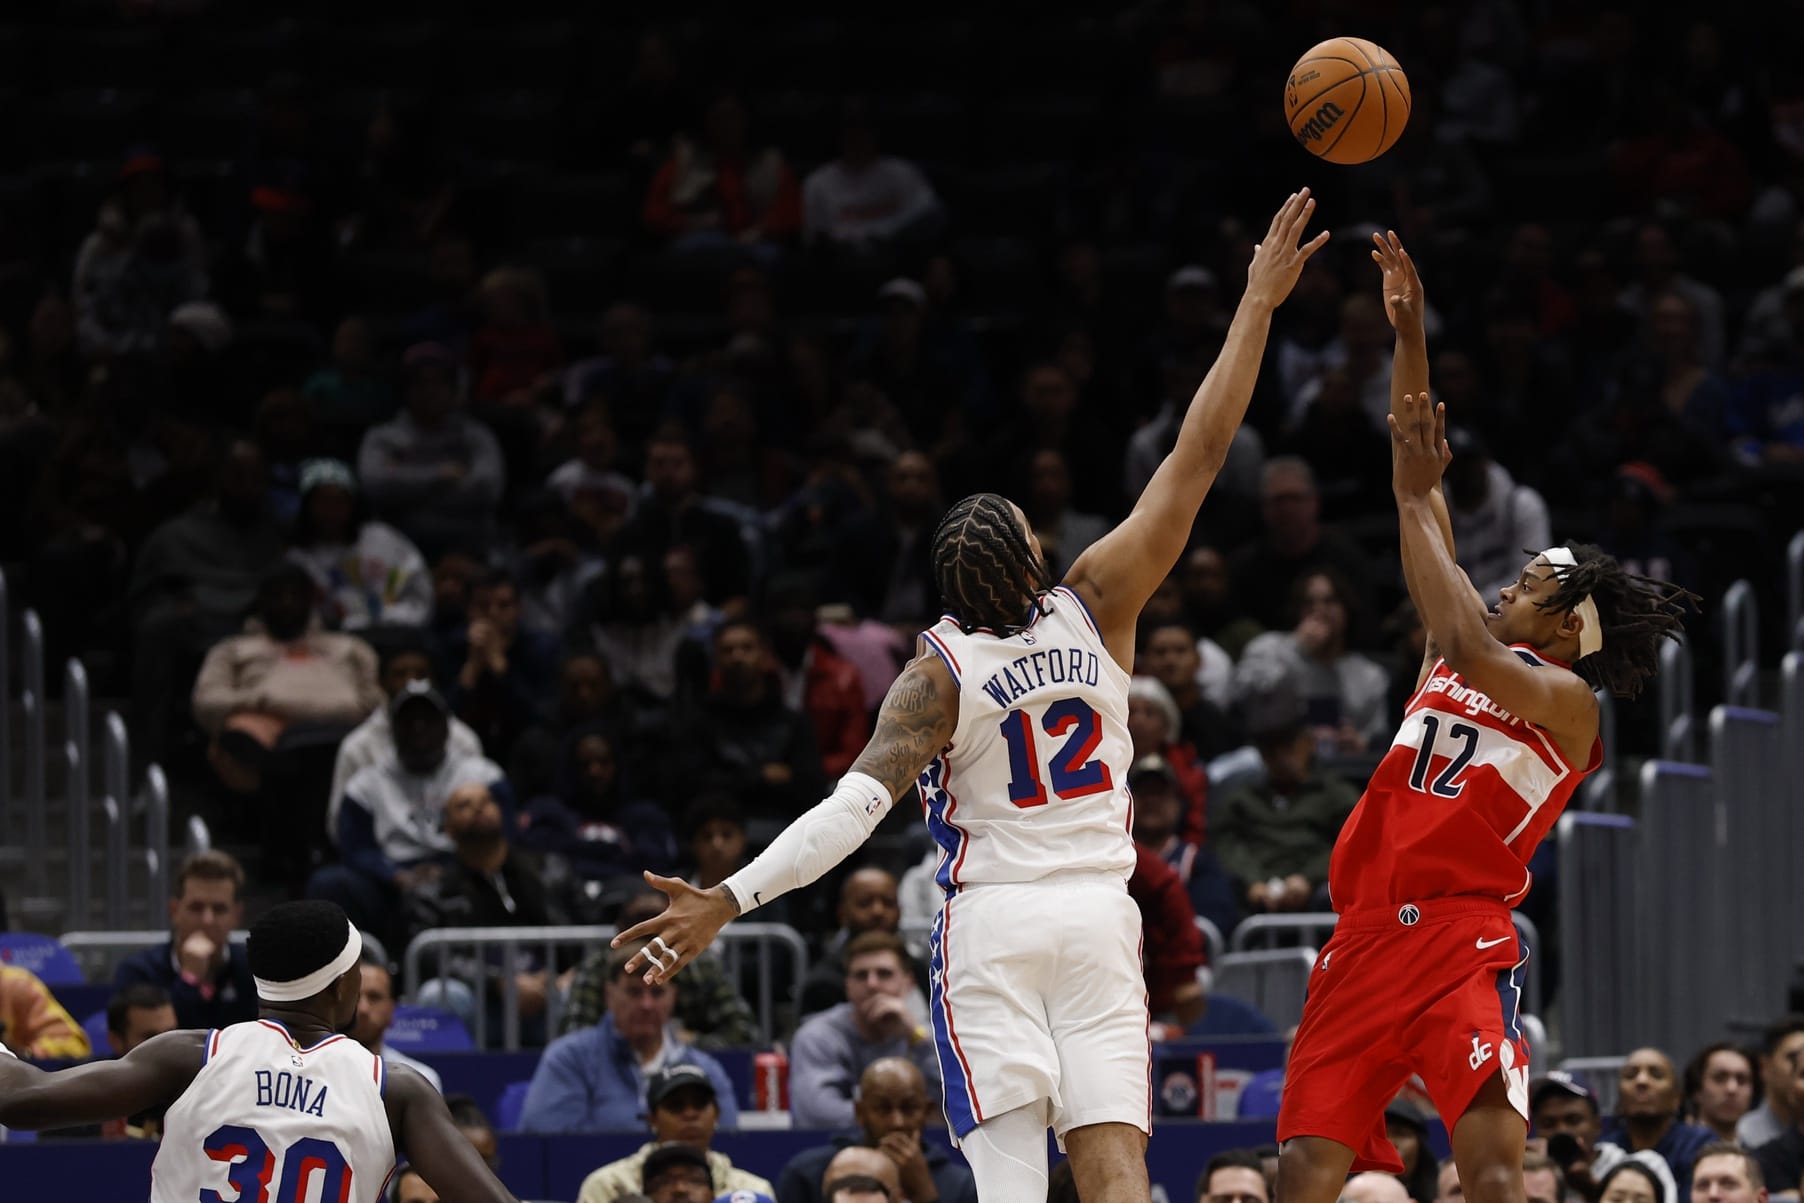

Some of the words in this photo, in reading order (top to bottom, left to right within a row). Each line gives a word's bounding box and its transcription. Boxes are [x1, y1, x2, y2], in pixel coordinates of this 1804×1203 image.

[982, 648, 1099, 709] WATFORD
[1000, 697, 1114, 809] 12
[1408, 714, 1479, 799] 12
[255, 1070, 328, 1117] BONA
[199, 1124, 353, 1203] 30
